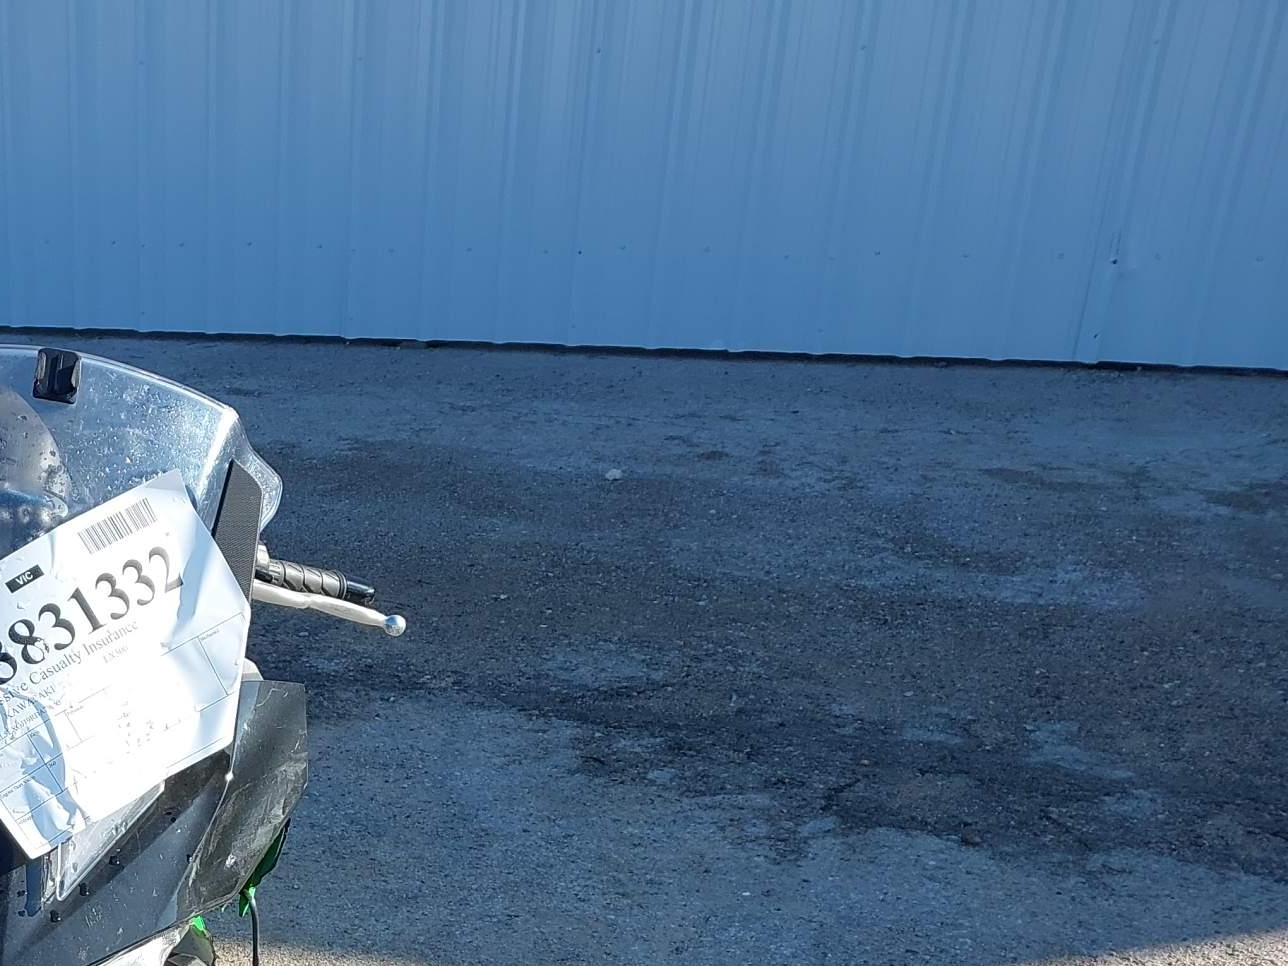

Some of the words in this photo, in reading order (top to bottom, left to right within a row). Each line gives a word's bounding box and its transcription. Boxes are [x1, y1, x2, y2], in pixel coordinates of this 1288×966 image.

[15, 571, 34, 585] VIC
[29, 651, 82, 685] Casualty
[83, 621, 139, 656] Insurance
